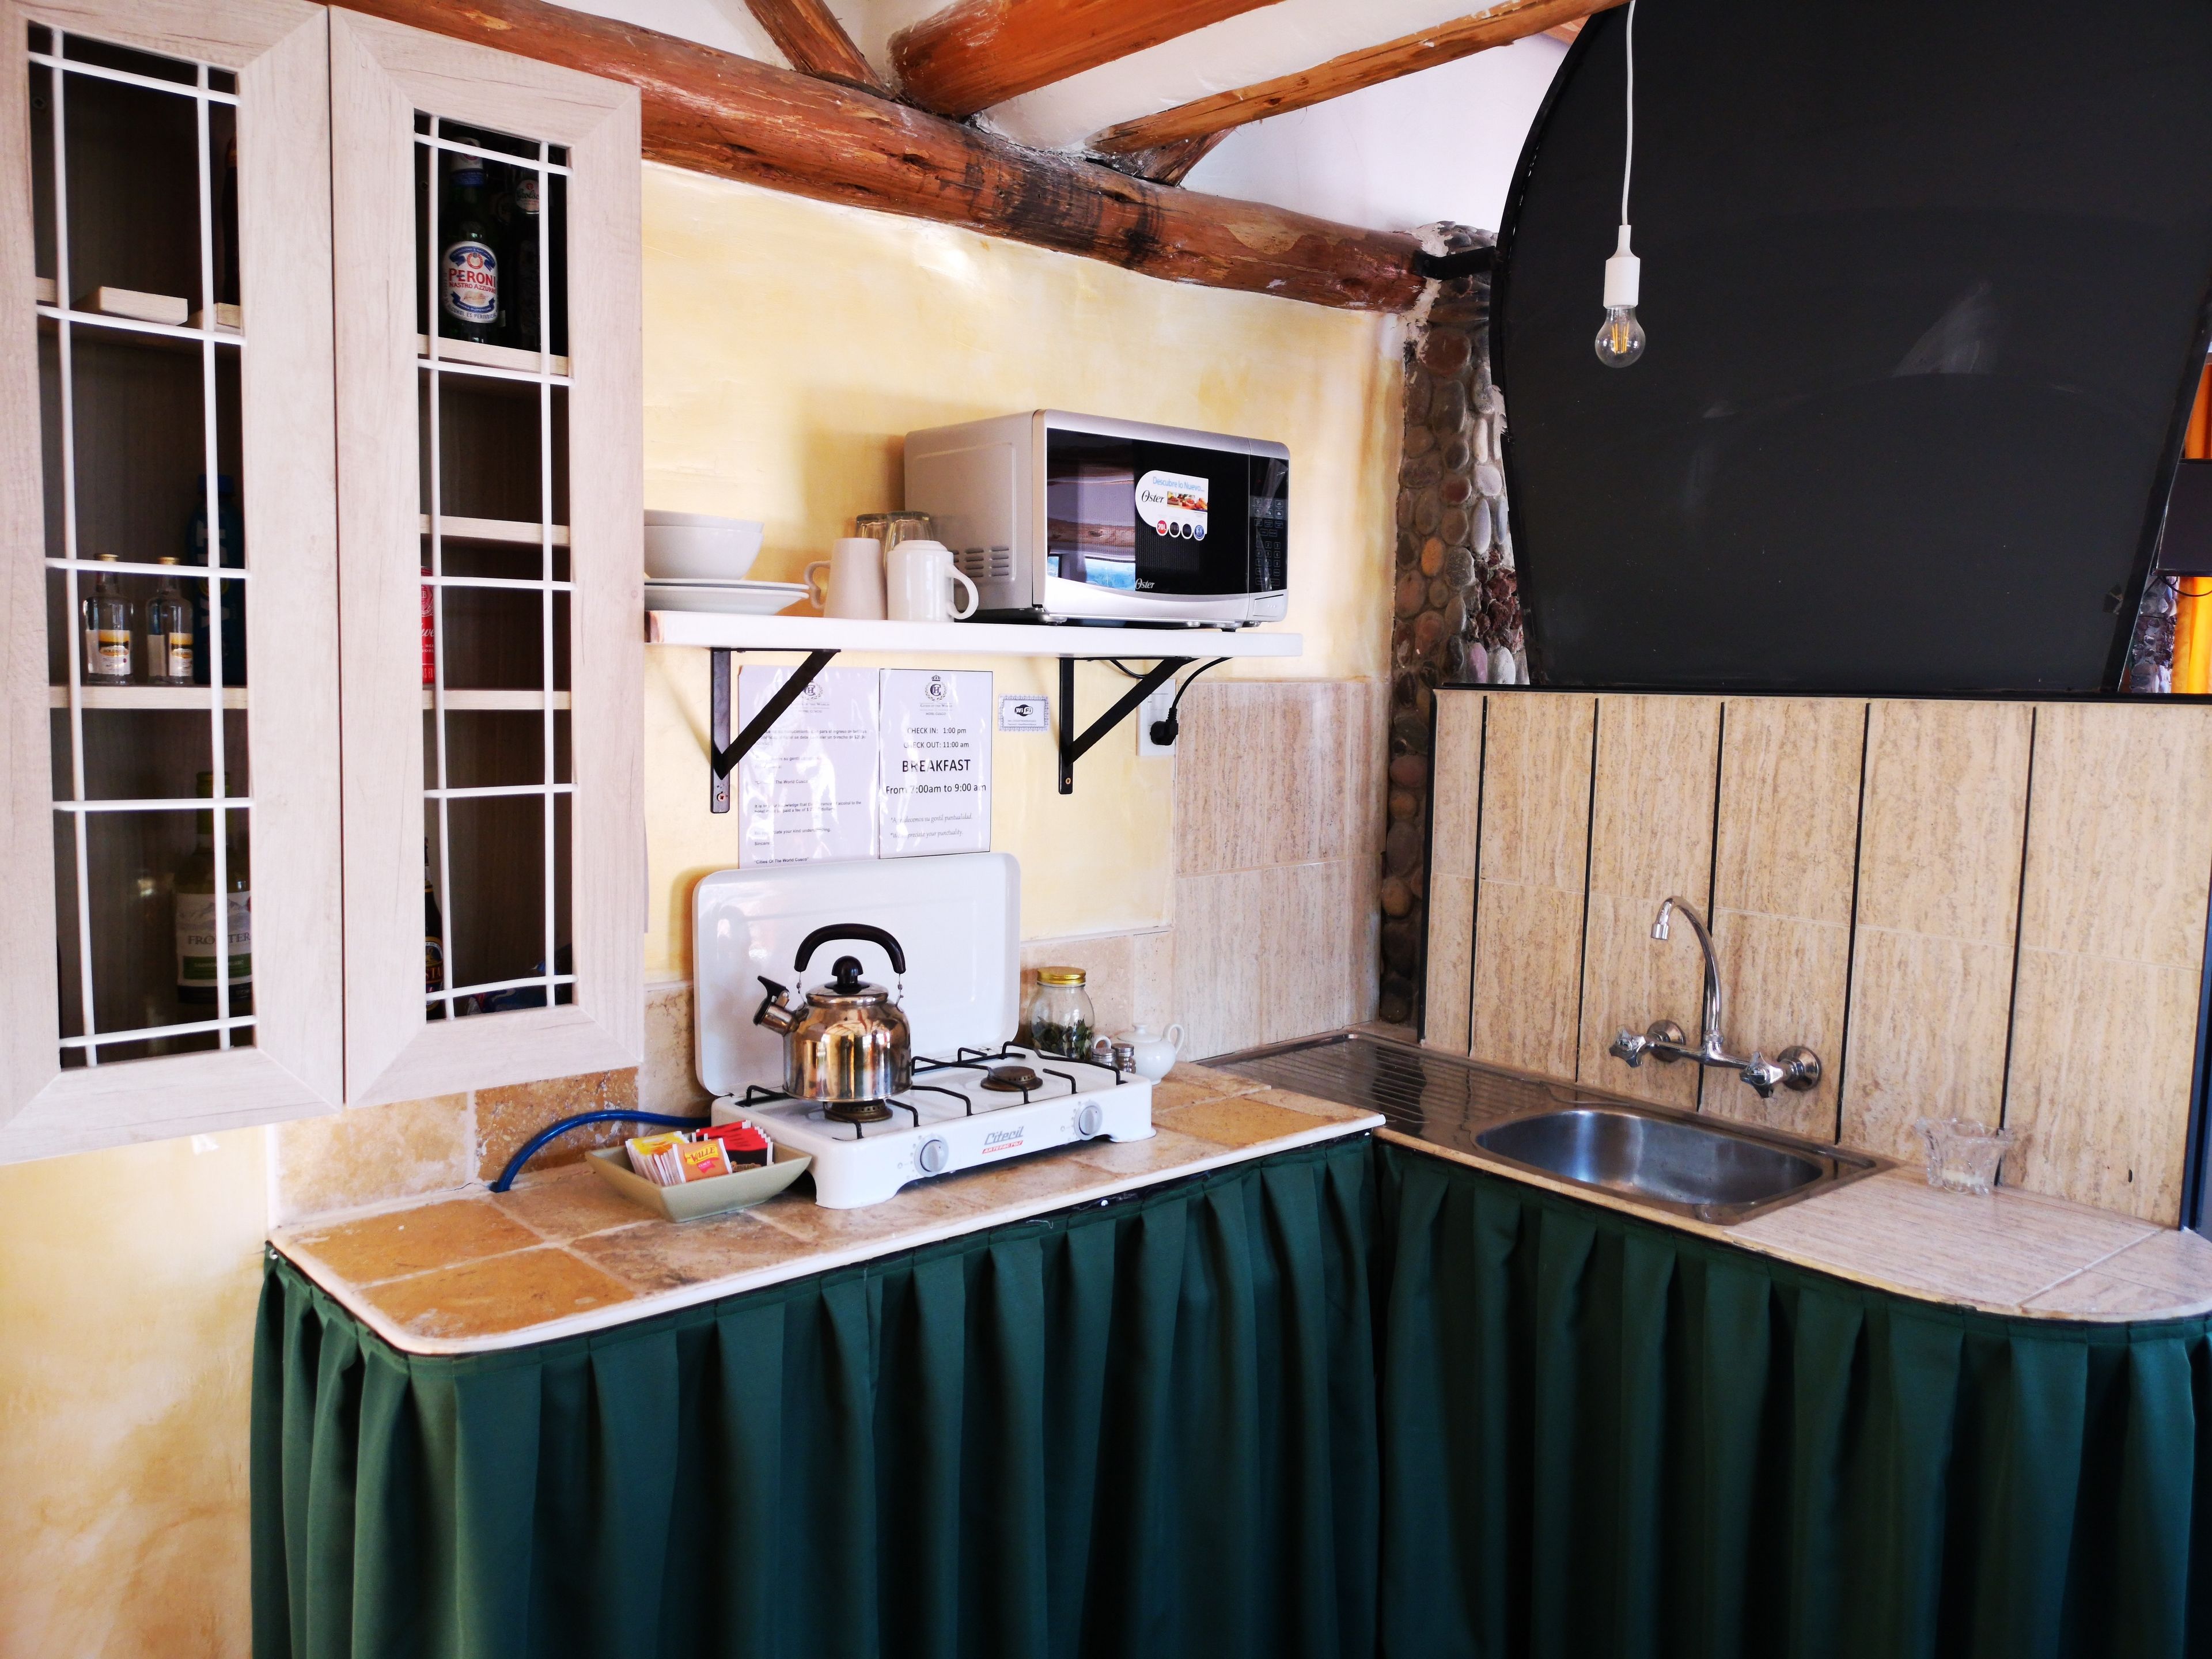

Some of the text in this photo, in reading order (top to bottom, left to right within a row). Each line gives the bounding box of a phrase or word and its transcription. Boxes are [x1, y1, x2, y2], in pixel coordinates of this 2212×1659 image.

[449, 268, 497, 287] PERONI
[474, 284, 497, 294] AZZURRO
[1153, 476, 1177, 488] Descubre
[1178, 480, 1183, 488] lo
[1142, 490, 1165, 503] Oster
[1135, 578, 1155, 589] Oster
[902, 759, 971, 772] BREAKFAST
[886, 786, 906, 794] From
[910, 785, 941, 793] 7:00am
[944, 784, 952, 792] to
[955, 783, 971, 791] 9:00
